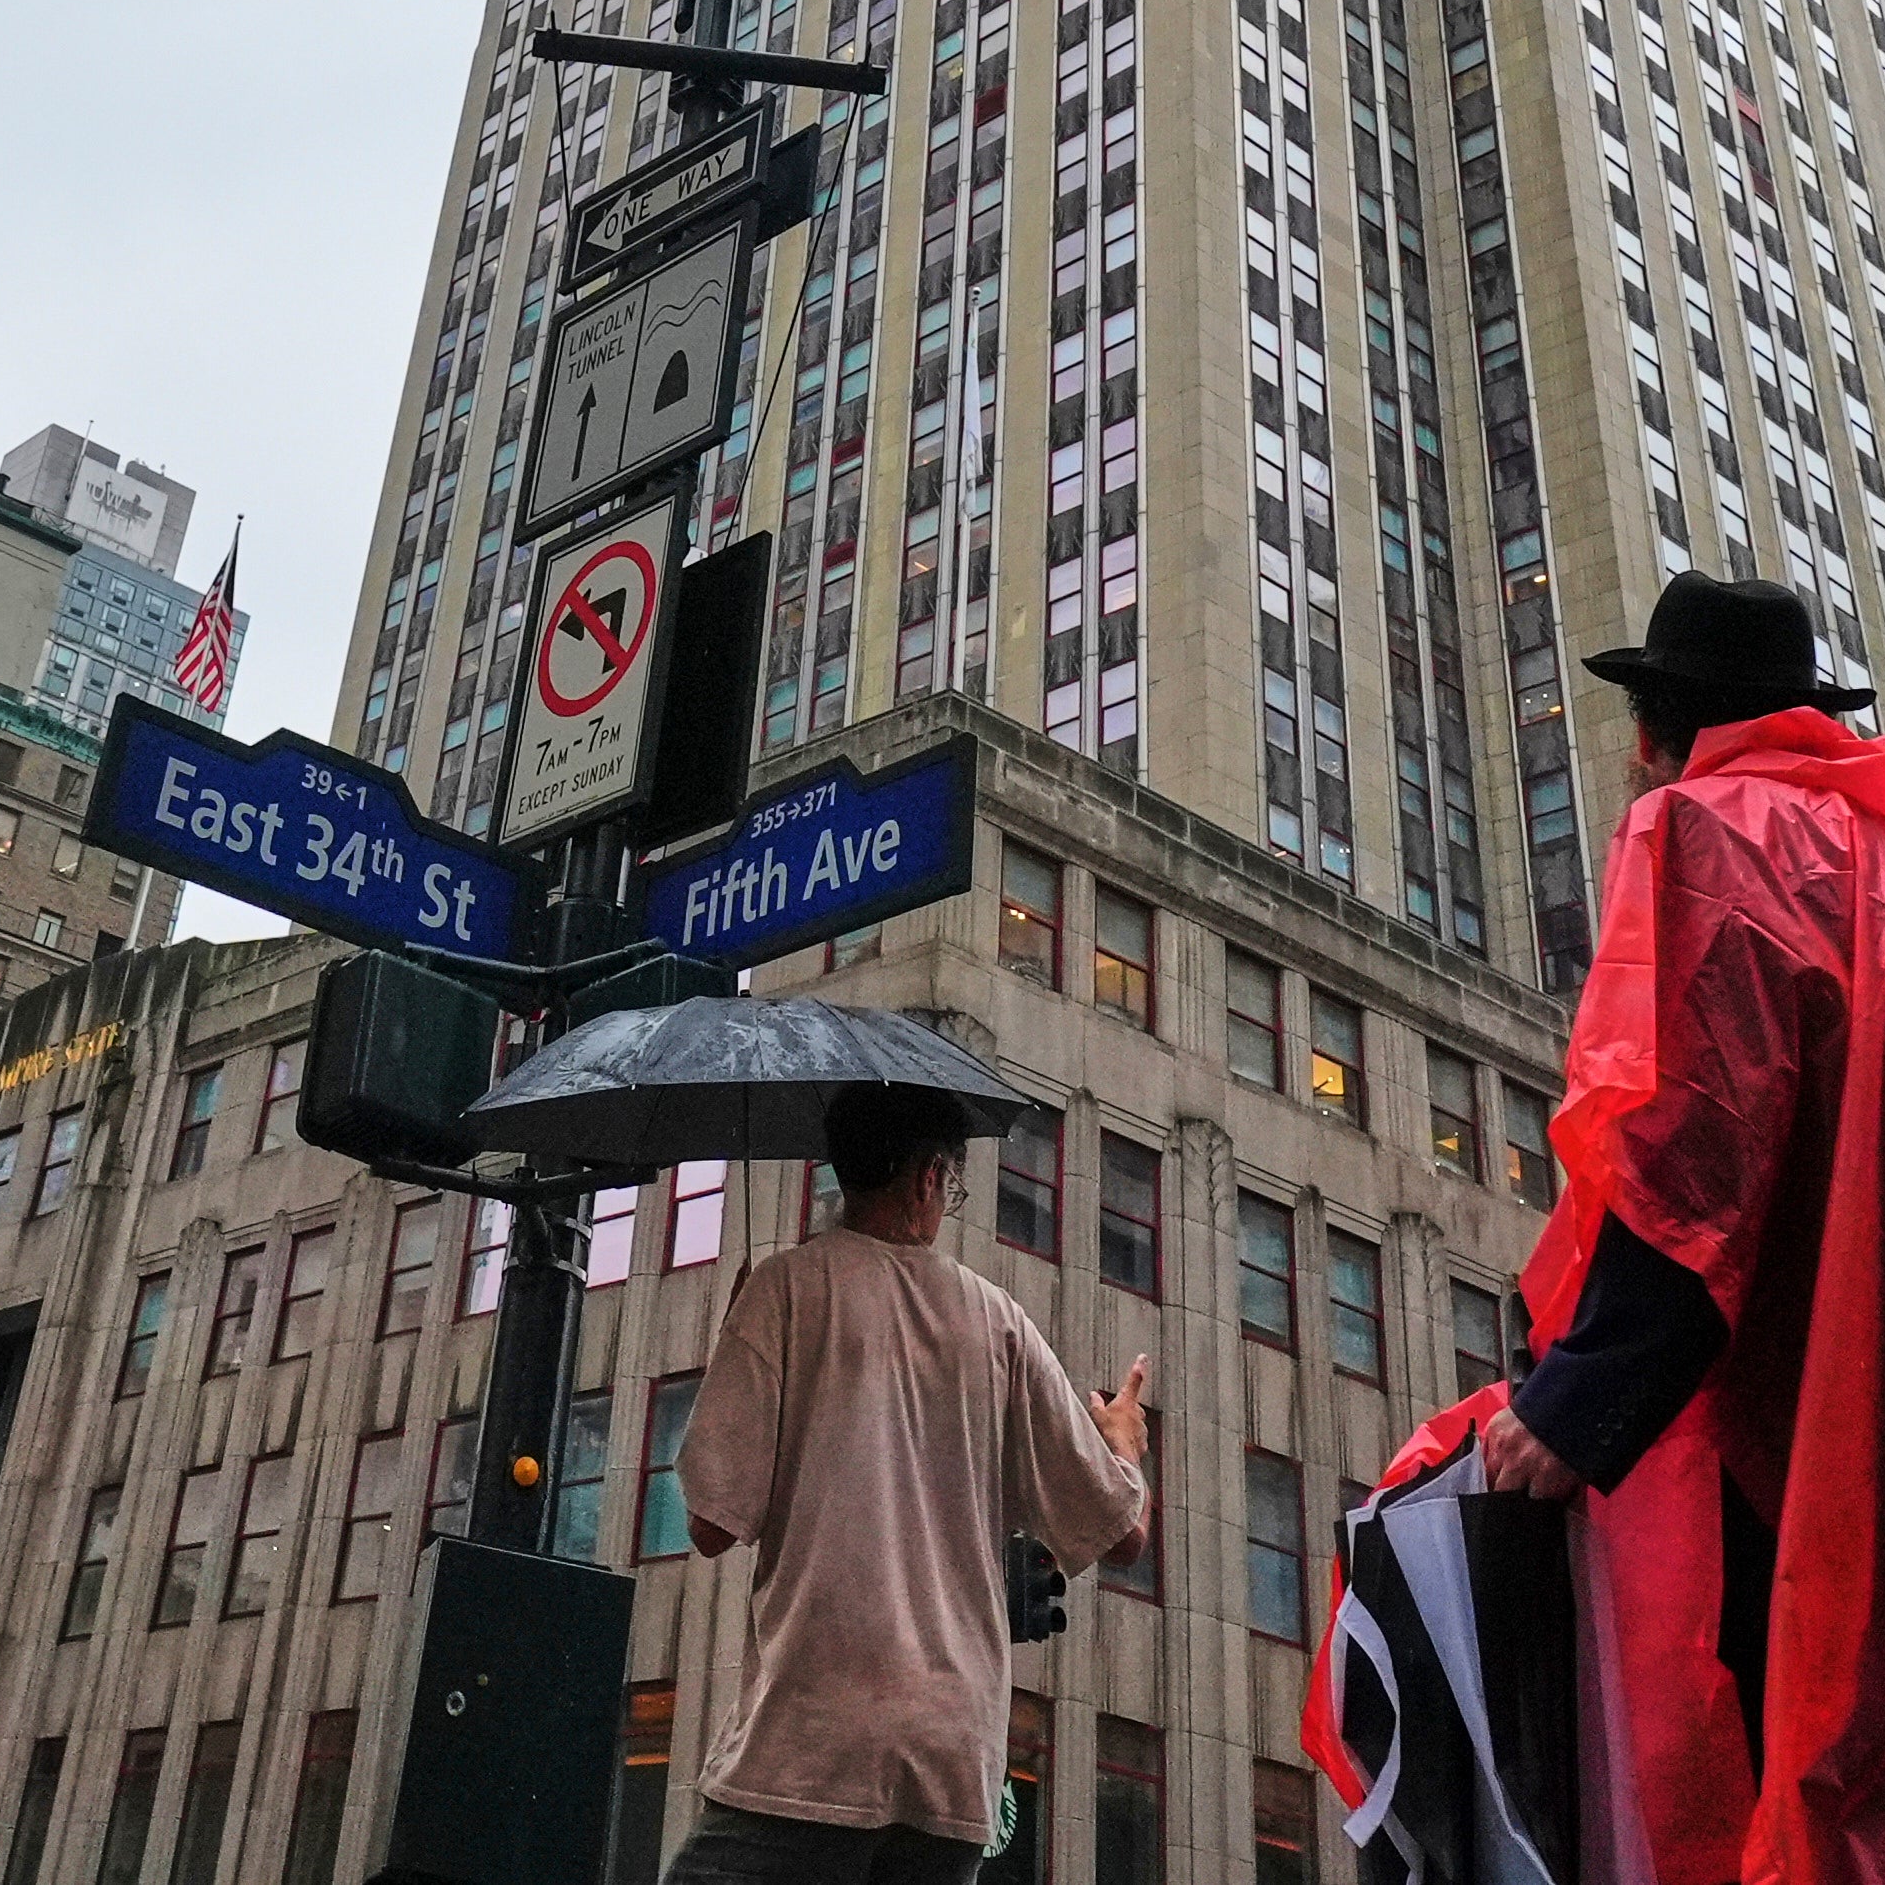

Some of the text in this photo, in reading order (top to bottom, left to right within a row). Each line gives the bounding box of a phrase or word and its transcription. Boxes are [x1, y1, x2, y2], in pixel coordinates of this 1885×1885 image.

[604, 192, 653, 240] ONE
[677, 148, 731, 199] WAY
[567, 335, 625, 385] TUNNEL
[568, 301, 636, 357] LINCOLN
[518, 780, 566, 815] EXCEPT
[572, 755, 624, 792] SUNDAY
[155, 756, 476, 942] East 34th St
[682, 819, 901, 947] Fifth Ave
